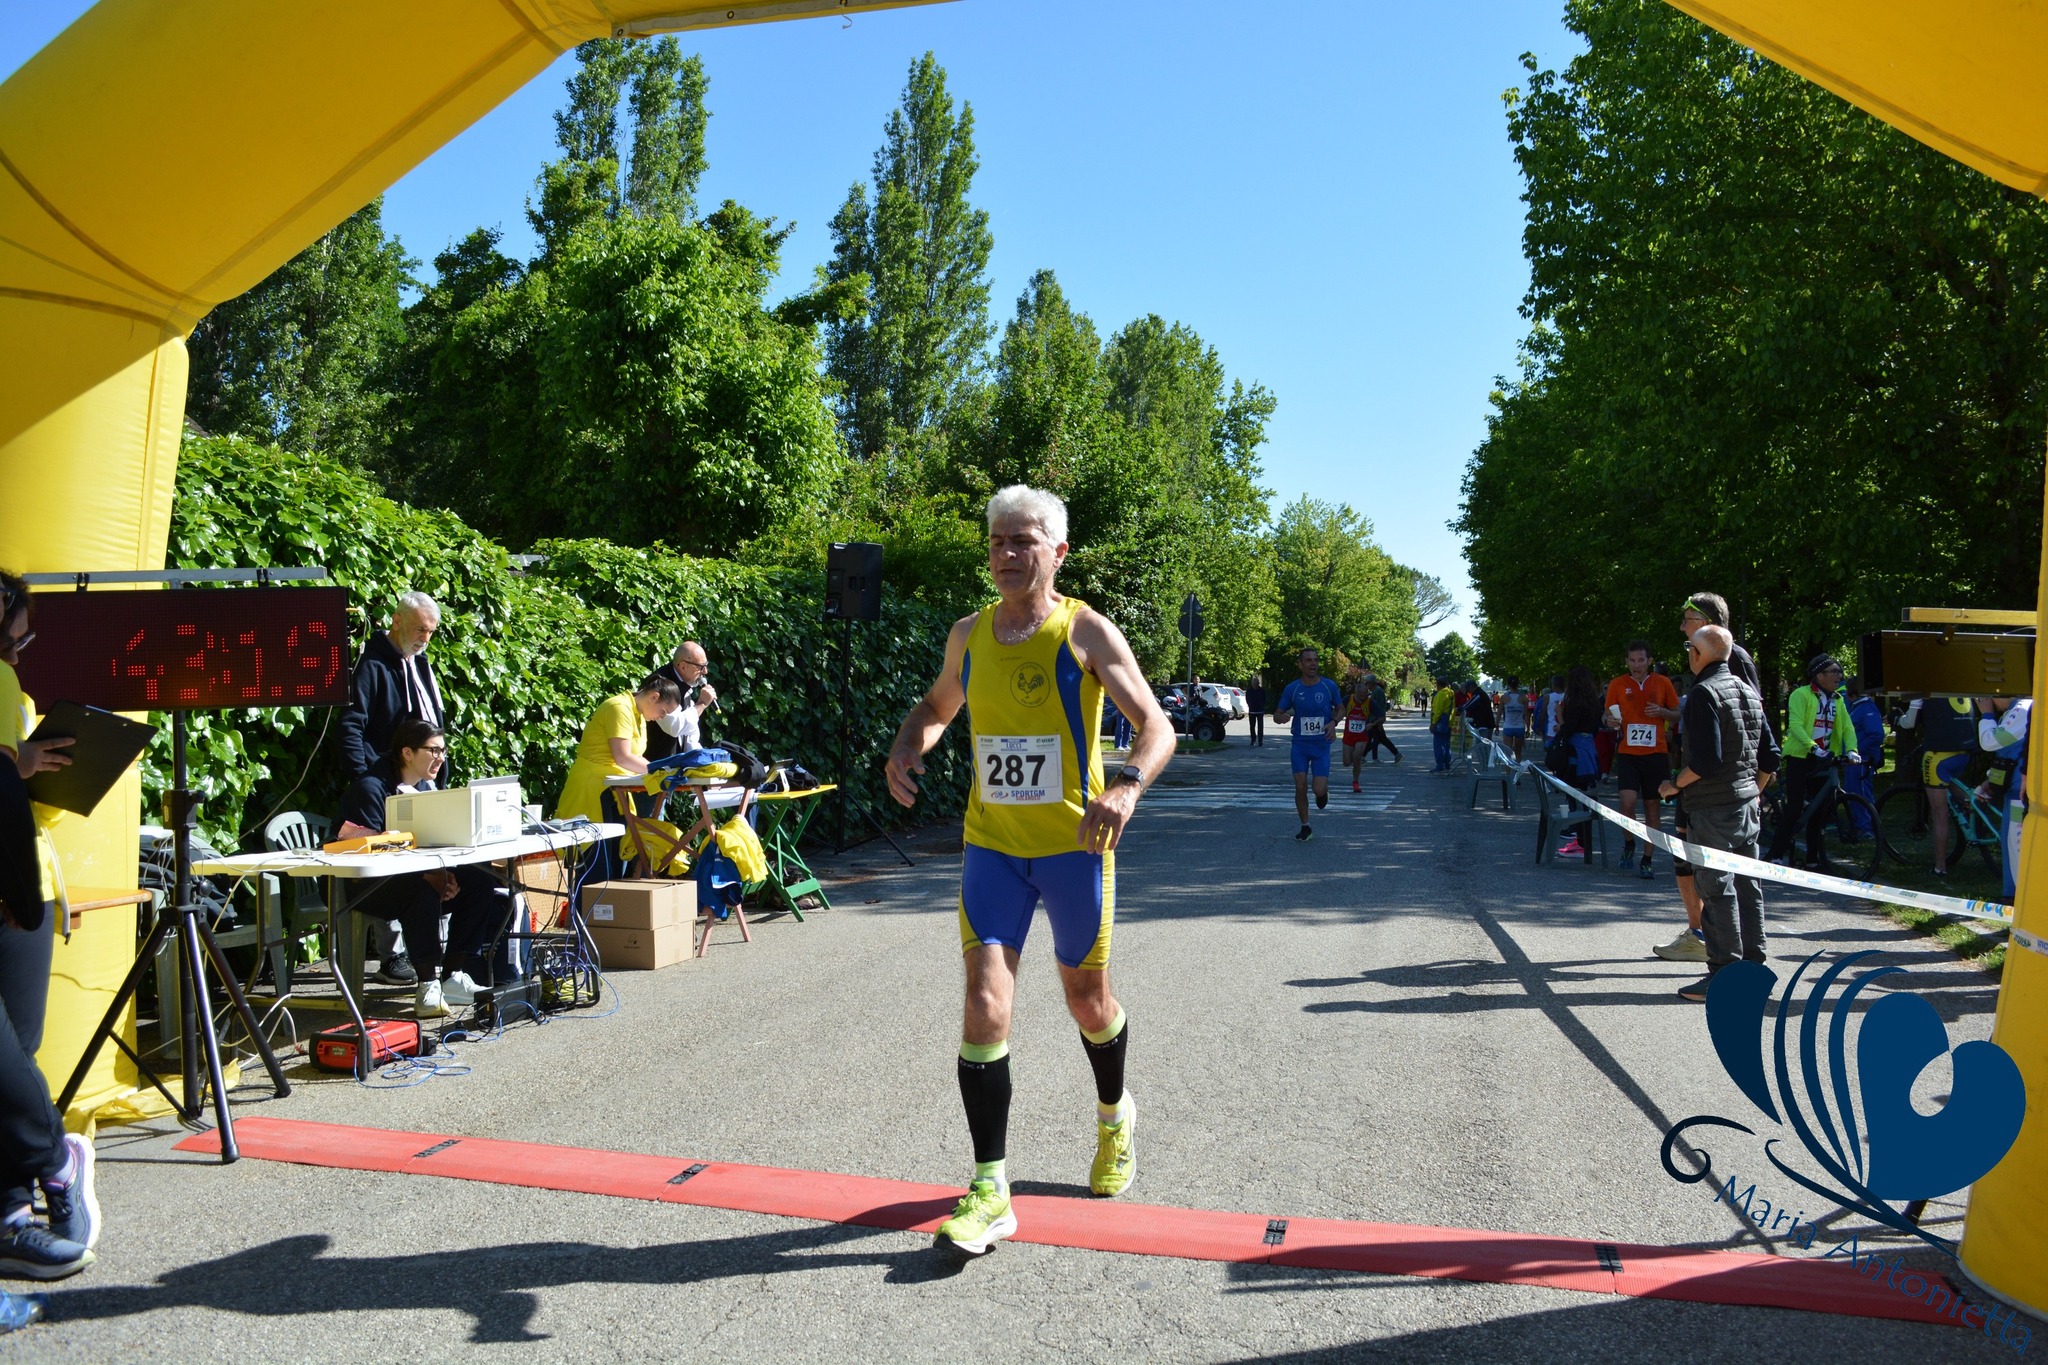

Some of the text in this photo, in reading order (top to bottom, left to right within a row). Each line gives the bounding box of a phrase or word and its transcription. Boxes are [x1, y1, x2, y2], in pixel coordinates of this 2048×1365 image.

[1304, 721, 1321, 731] 184
[1631, 729, 1652, 741] 274
[986, 754, 1046, 787] 287
